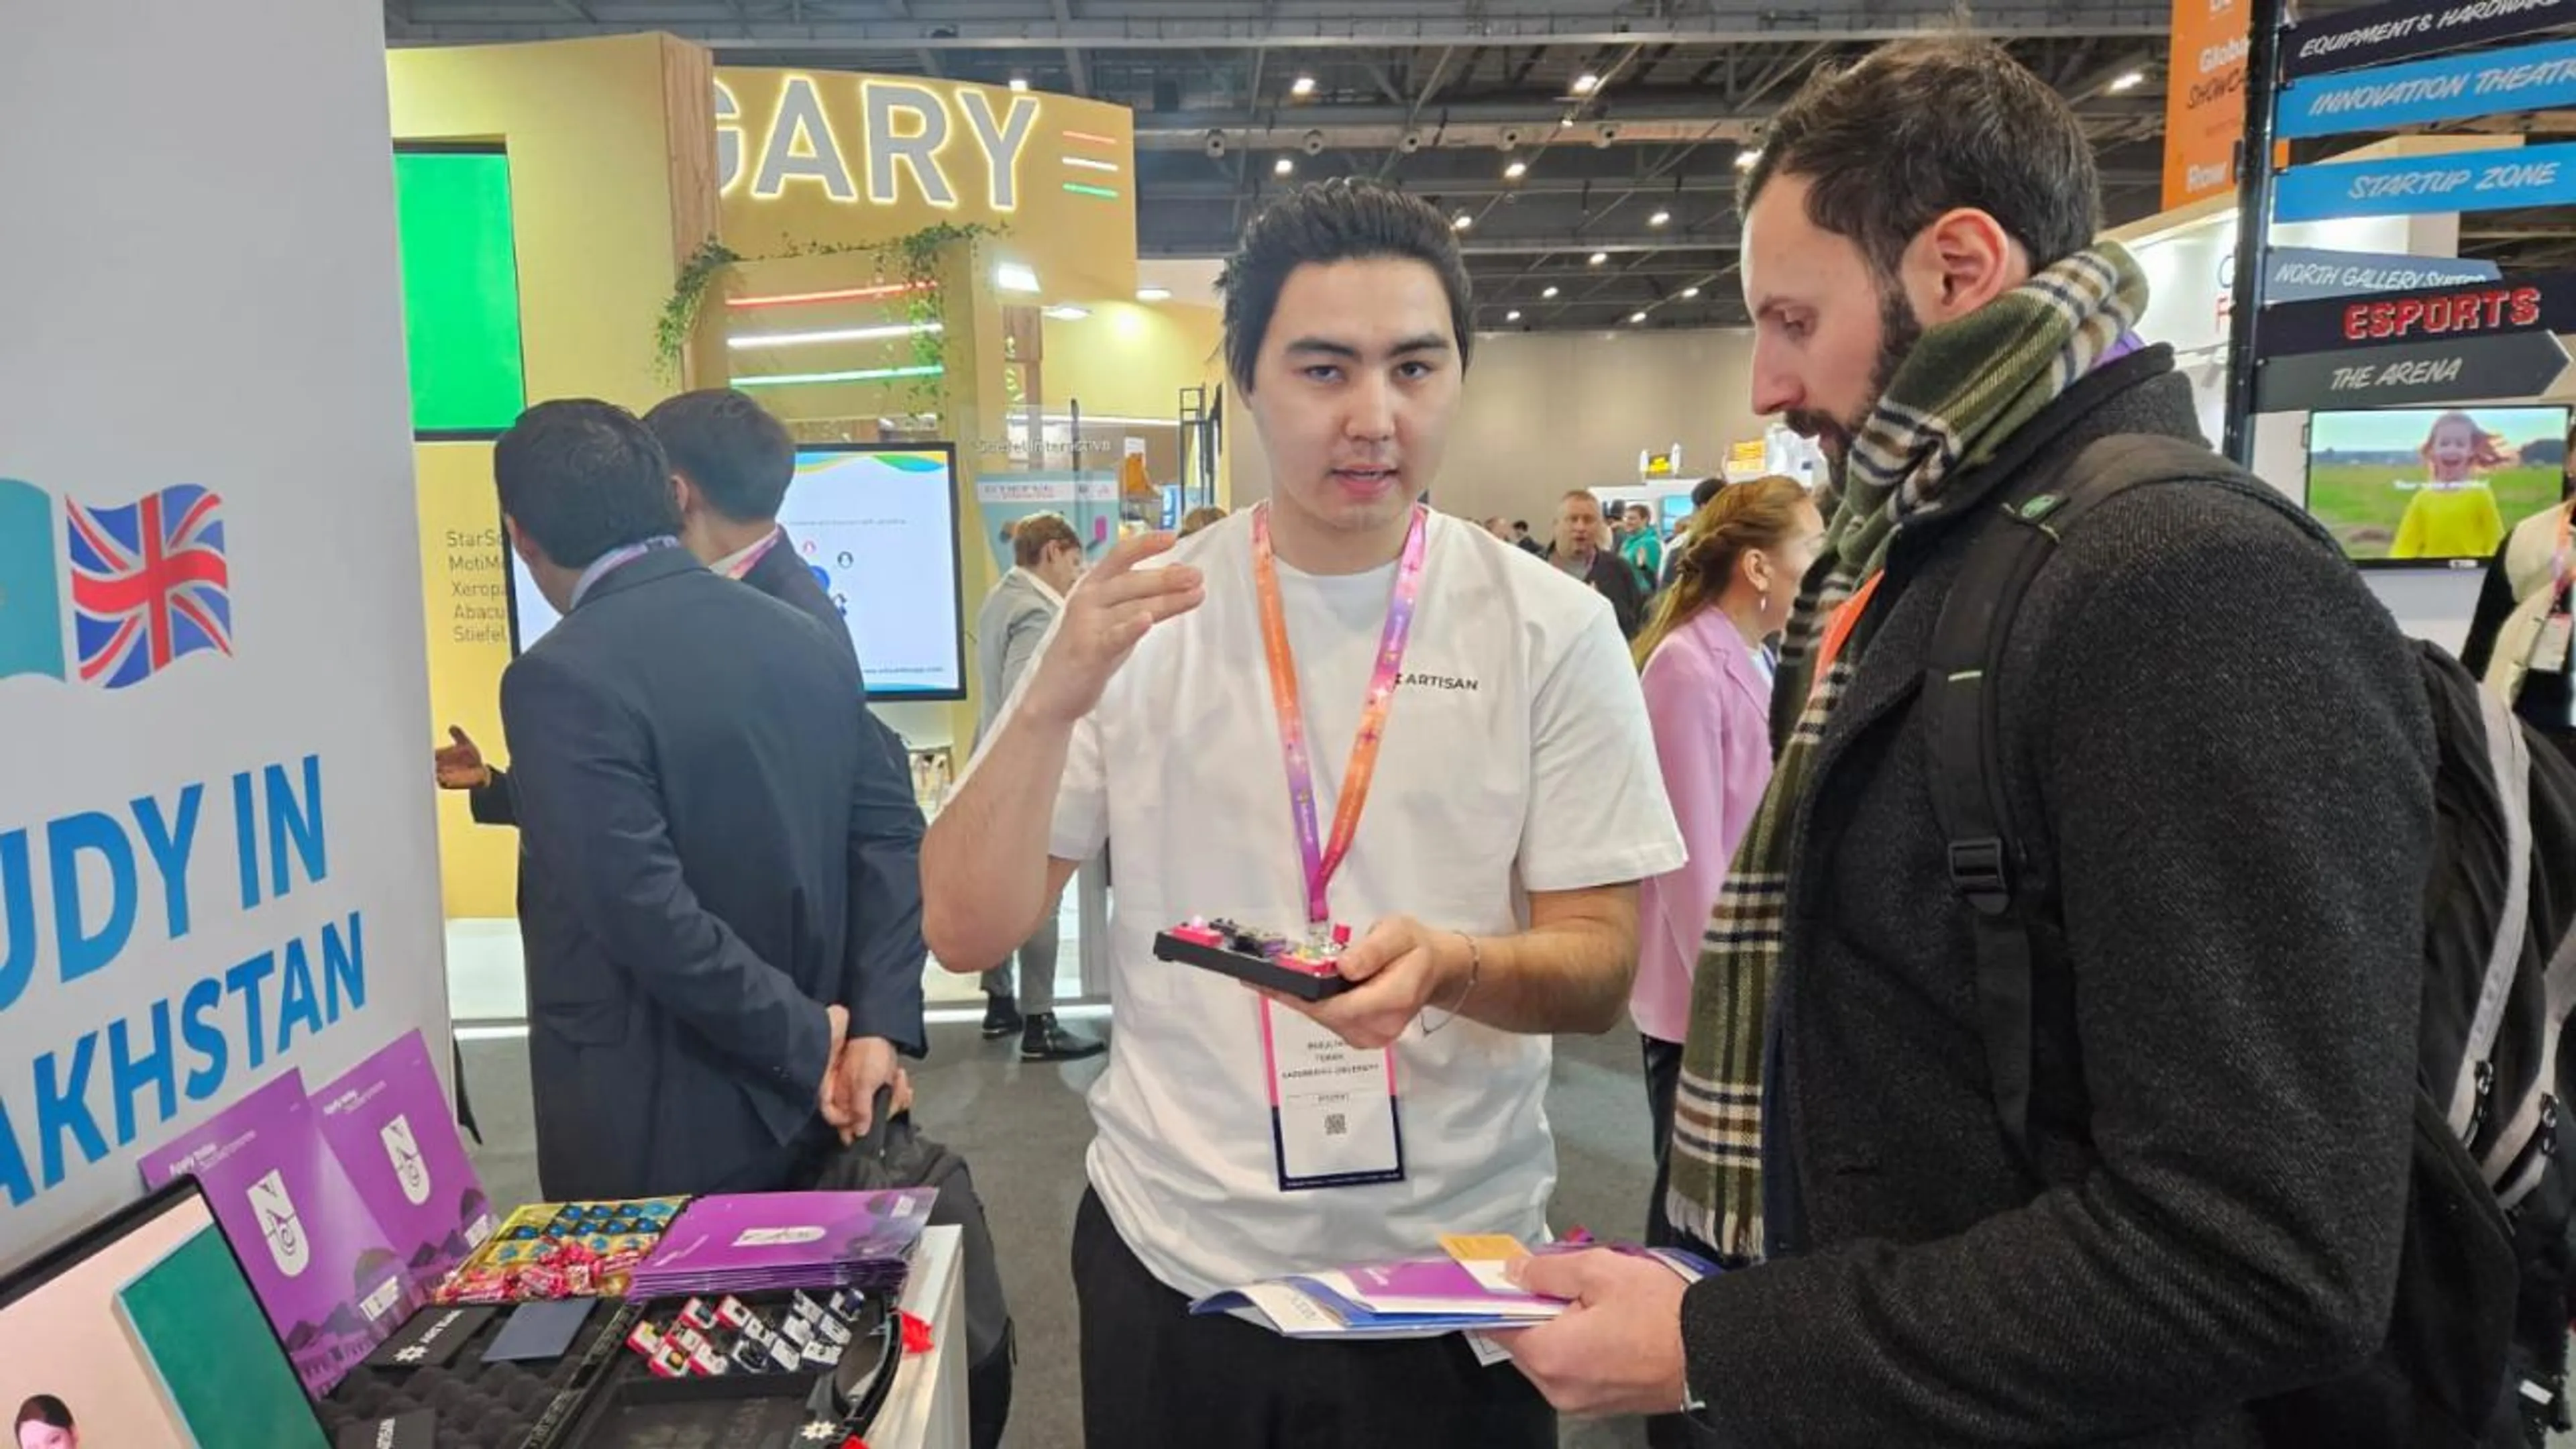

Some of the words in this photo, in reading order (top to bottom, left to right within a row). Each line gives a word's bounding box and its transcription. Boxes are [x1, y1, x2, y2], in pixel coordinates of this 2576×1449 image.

[2299, 17, 2416, 58] EQUIPMENT
[2417, 13, 2433, 32] &
[2308, 73, 2468, 116] INNOVATION
[2349, 170, 2472, 199] STARTUP
[2476, 162, 2561, 191] ZONE
[2275, 262, 2343, 284] NORTH
[2342, 266, 2424, 290] GALLERY
[2343, 287, 2541, 340] ESPORTS
[2329, 366, 2373, 391] THE
[2375, 357, 2463, 386] ARENA
[445, 529, 502, 547] StarS
[448, 555, 500, 570] MotiM
[451, 581, 505, 600] Xerop
[1405, 674, 1479, 691] ARTISAN
[233, 755, 326, 910] IN
